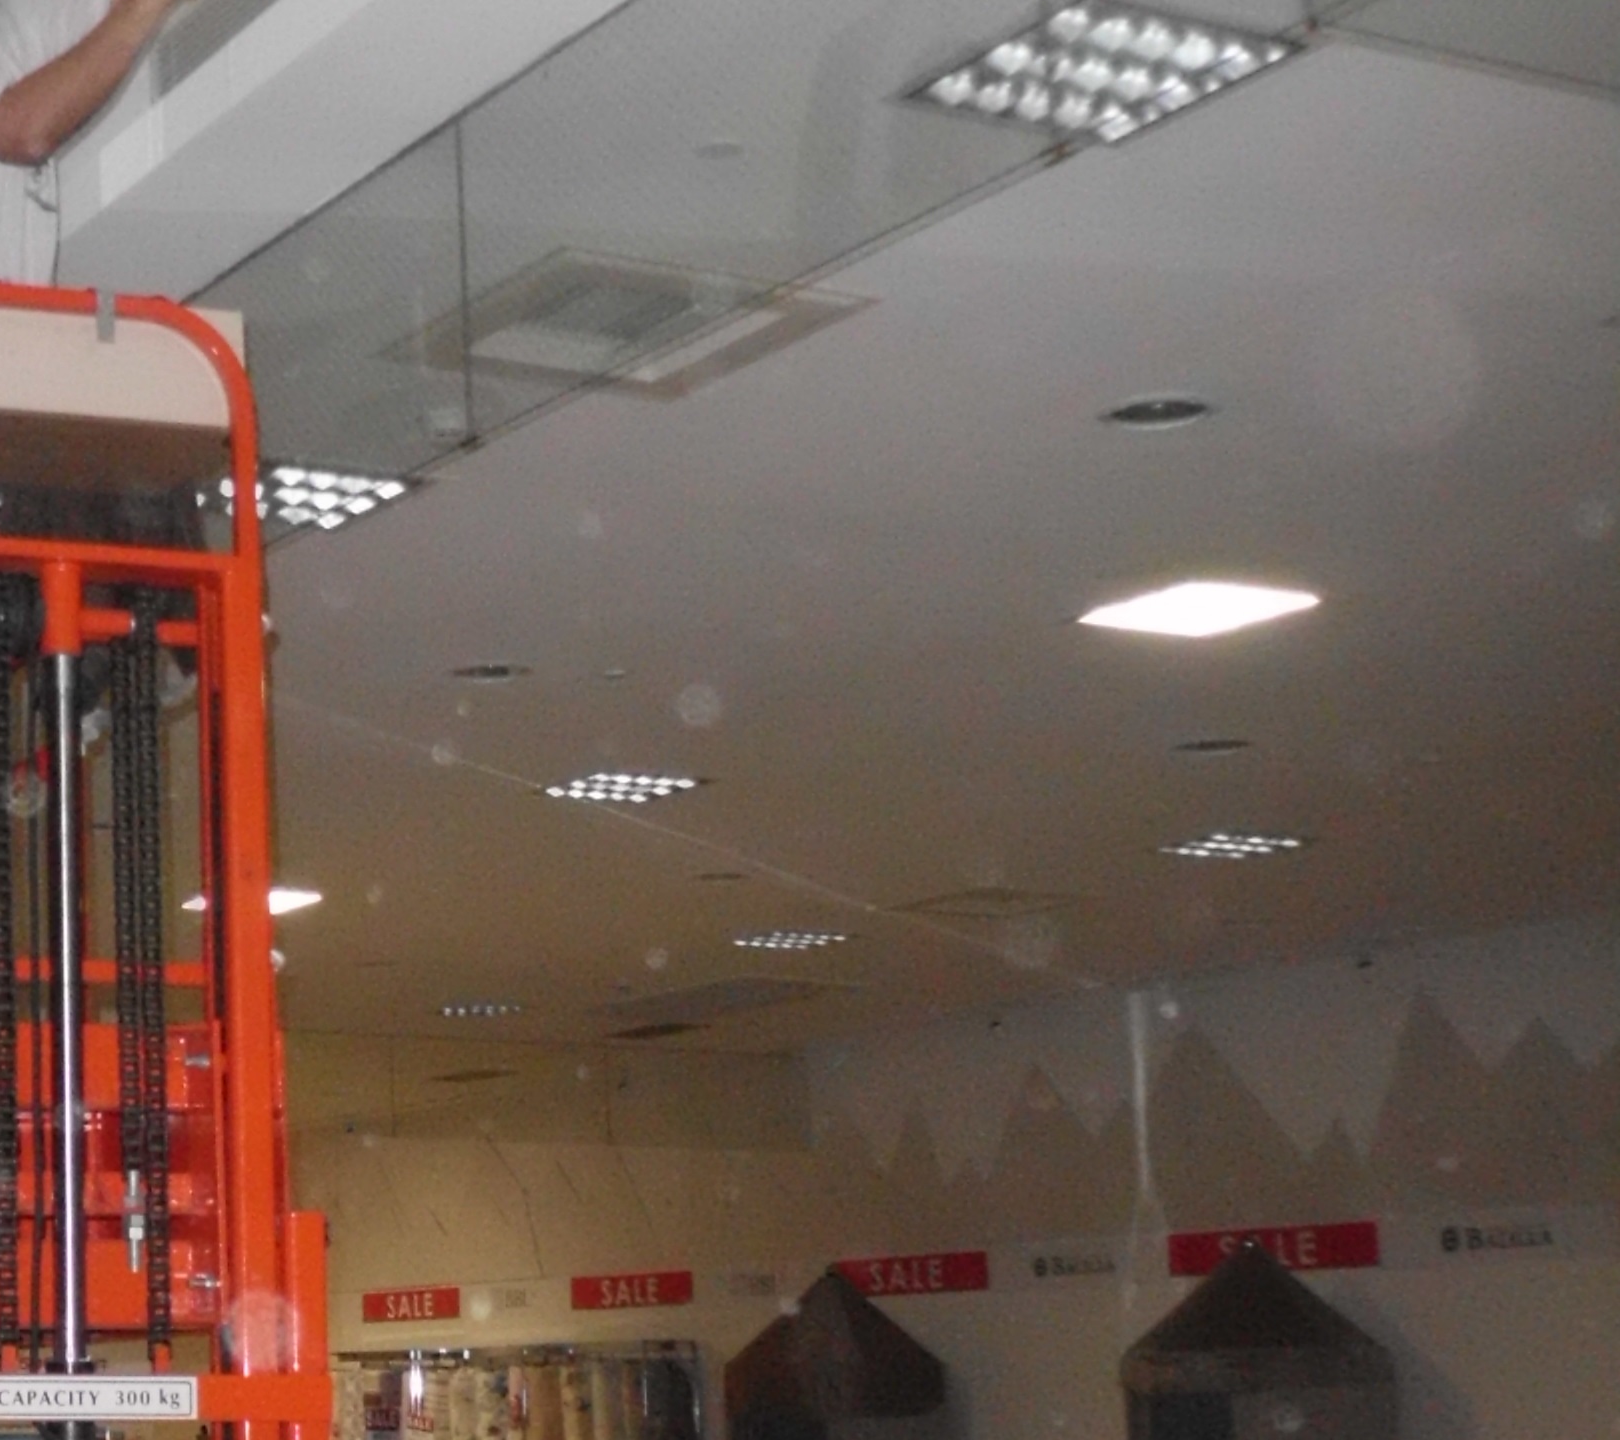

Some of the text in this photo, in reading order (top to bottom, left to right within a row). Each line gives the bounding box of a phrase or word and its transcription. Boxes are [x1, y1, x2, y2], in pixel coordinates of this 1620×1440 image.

[1218, 1229, 1318, 1266] SLE
[869, 1258, 944, 1292] SALE
[386, 1292, 434, 1319] SALE
[600, 1276, 660, 1307] SALE
[115, 1389, 151, 1406] 300
[158, 1388, 181, 1410] kg
